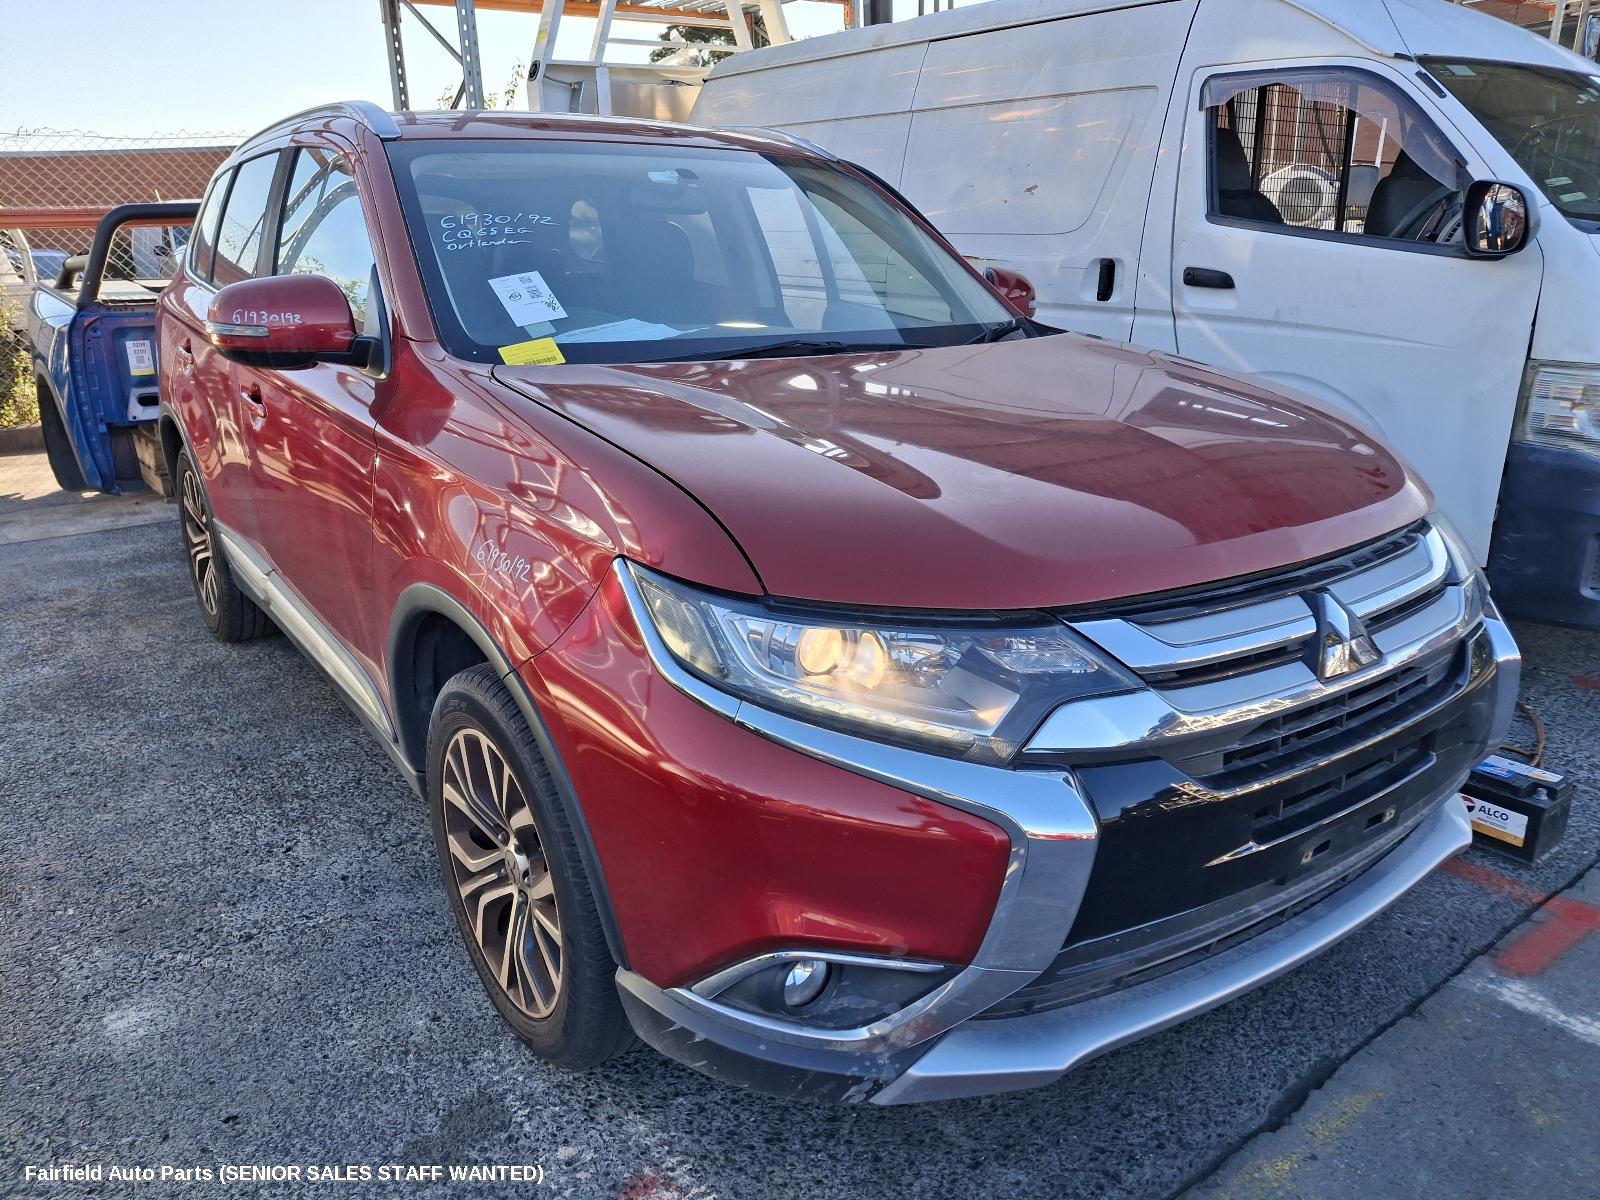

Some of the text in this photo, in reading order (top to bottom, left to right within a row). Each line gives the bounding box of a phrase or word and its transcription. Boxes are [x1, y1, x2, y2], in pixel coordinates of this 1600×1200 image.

[232, 309, 302, 325] 61930192
[476, 540, 531, 583] 61930192
[1478, 805, 1509, 821] ALCO
